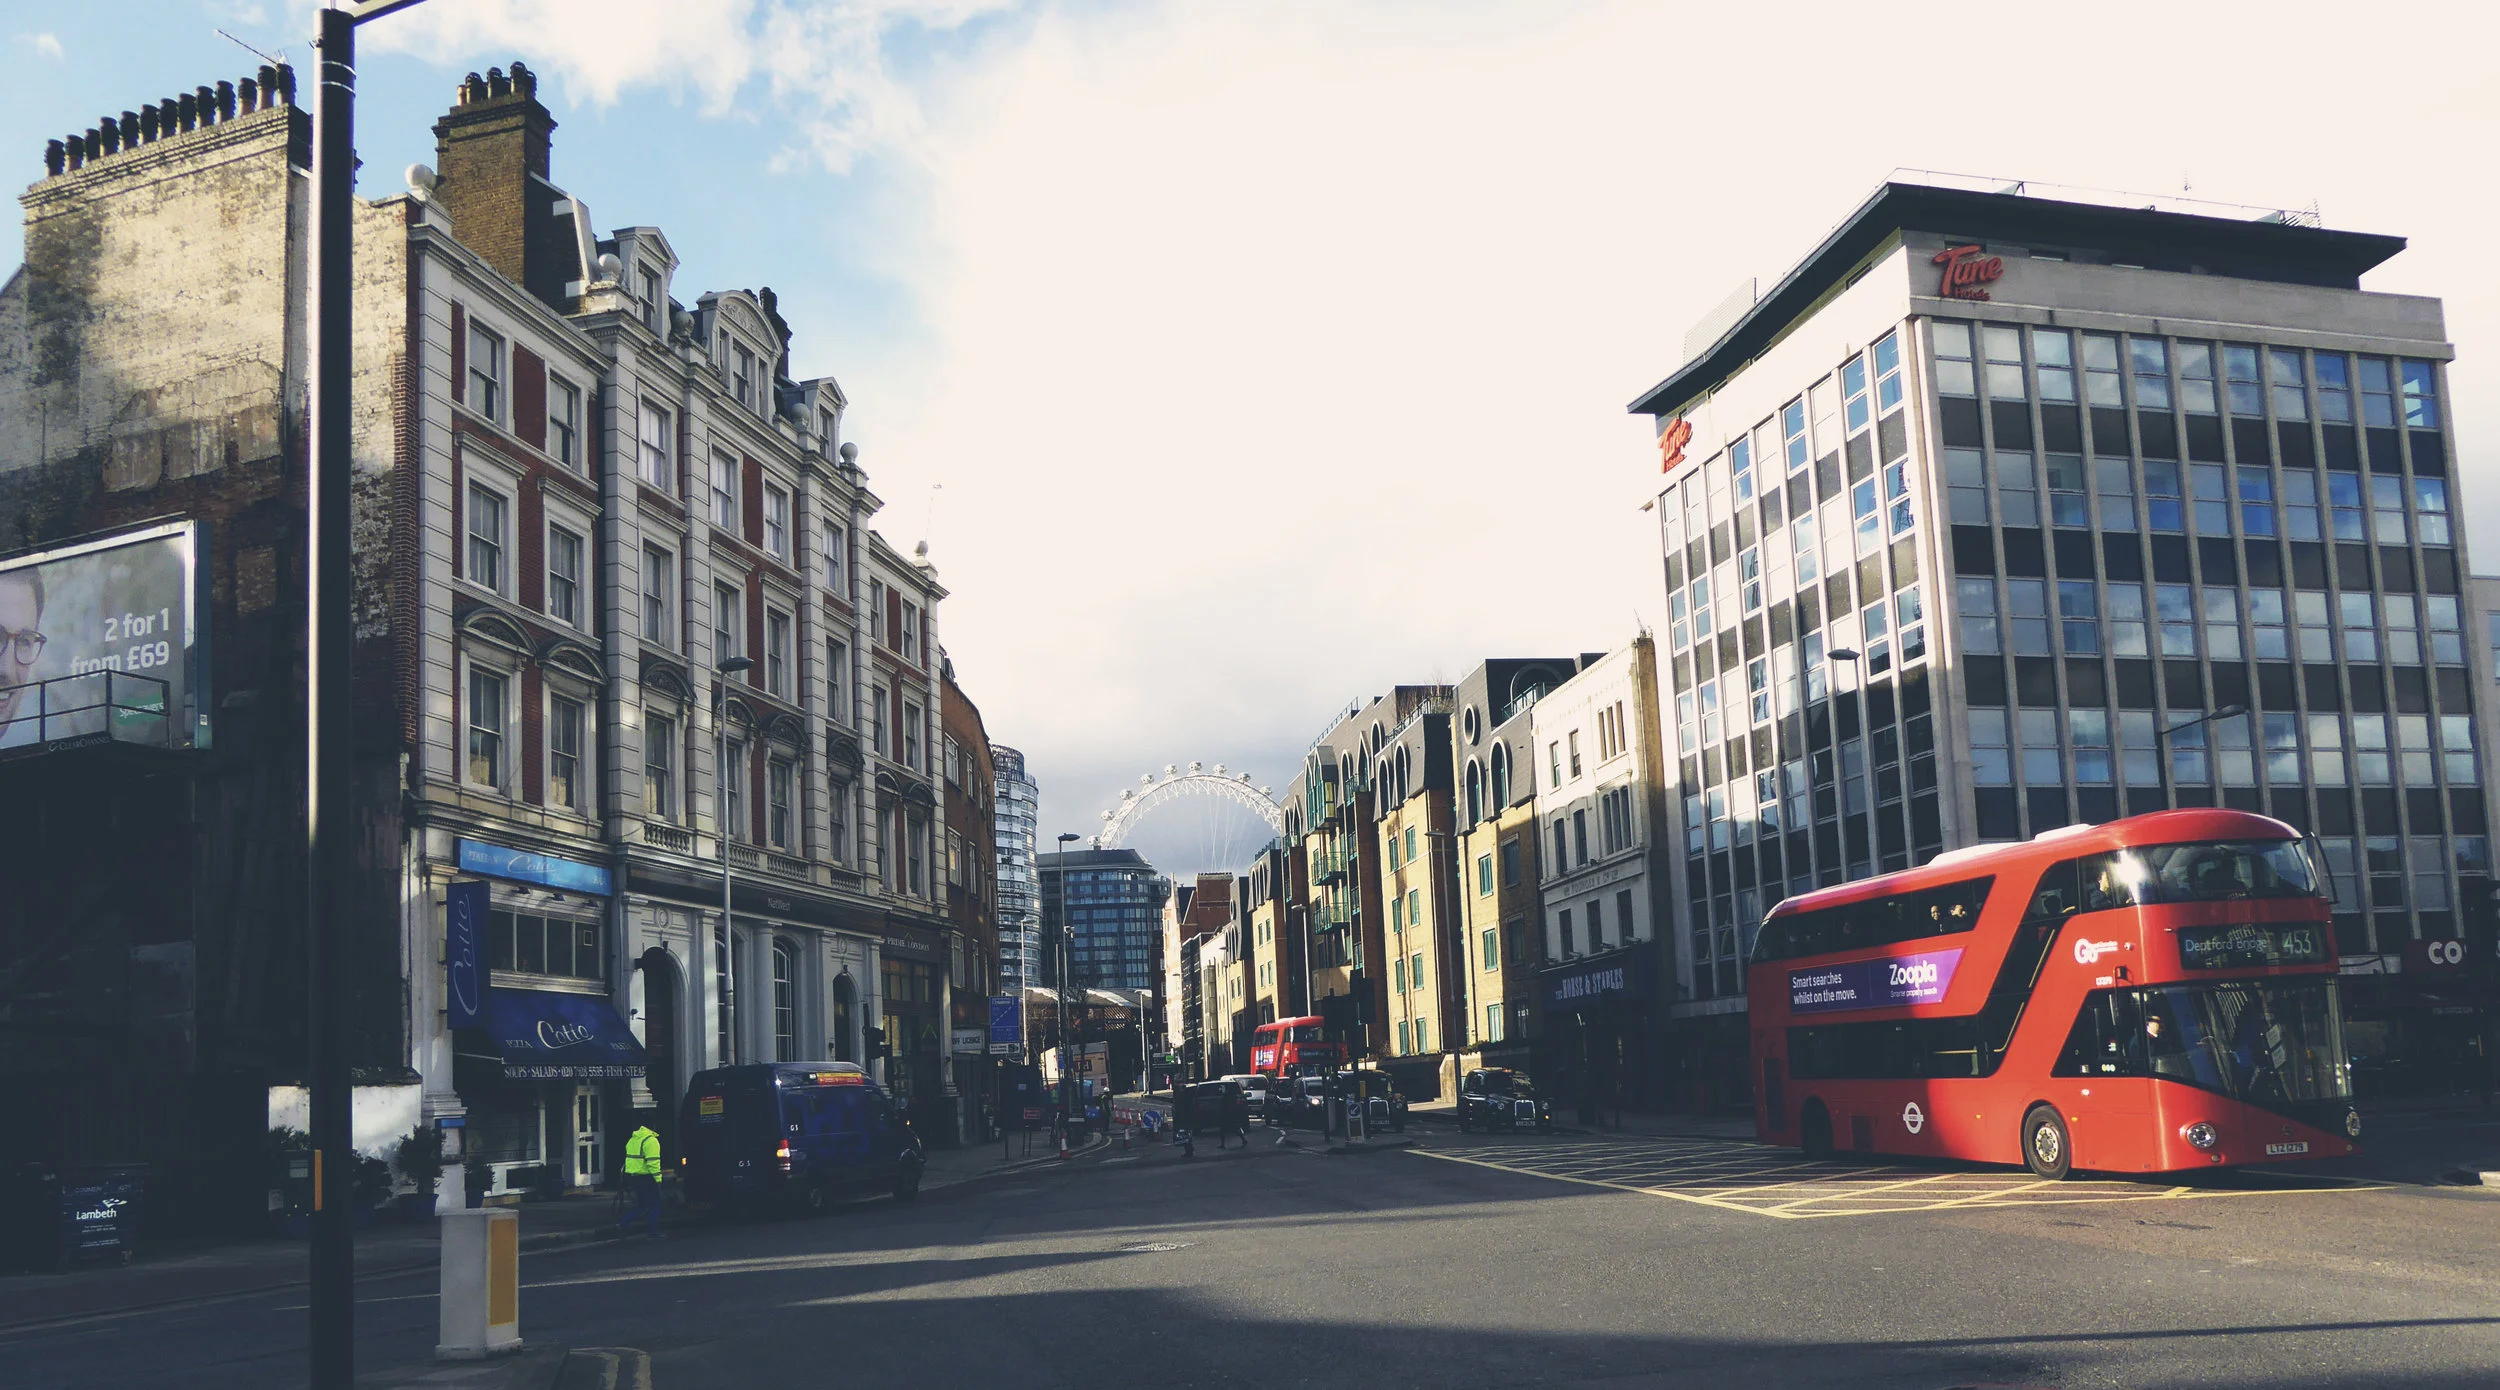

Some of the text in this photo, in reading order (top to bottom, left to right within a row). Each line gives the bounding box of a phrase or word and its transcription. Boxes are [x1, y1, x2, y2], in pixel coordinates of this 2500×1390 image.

[1932, 245, 2003, 297] Tune
[105, 607, 169, 642] 2 for 1
[71, 641, 170, 681] from £69
[507, 854, 562, 874] Cotto
[767, 896, 791, 911] NatWest
[887, 937, 930, 952] PRIME LONDON
[2185, 929, 2311, 954] Deptford Bridge 453
[453, 893, 478, 1016] Cotto
[1562, 976, 1583, 999] HORSE
[1585, 974, 1591, 995] &
[1592, 967, 1624, 994] STABLES
[1792, 972, 1842, 989] Smart searches
[1889, 960, 1937, 991] Zoopla
[1794, 989, 1857, 1005] whilst on the move.
[537, 1020, 594, 1049] Cotto
[504, 1066, 527, 1079] SOUPS
[531, 1065, 558, 1078] SALADS
[560, 1065, 573, 1078] 020
[606, 1065, 623, 1077] FISH
[76, 1208, 117, 1220] Lambeth
